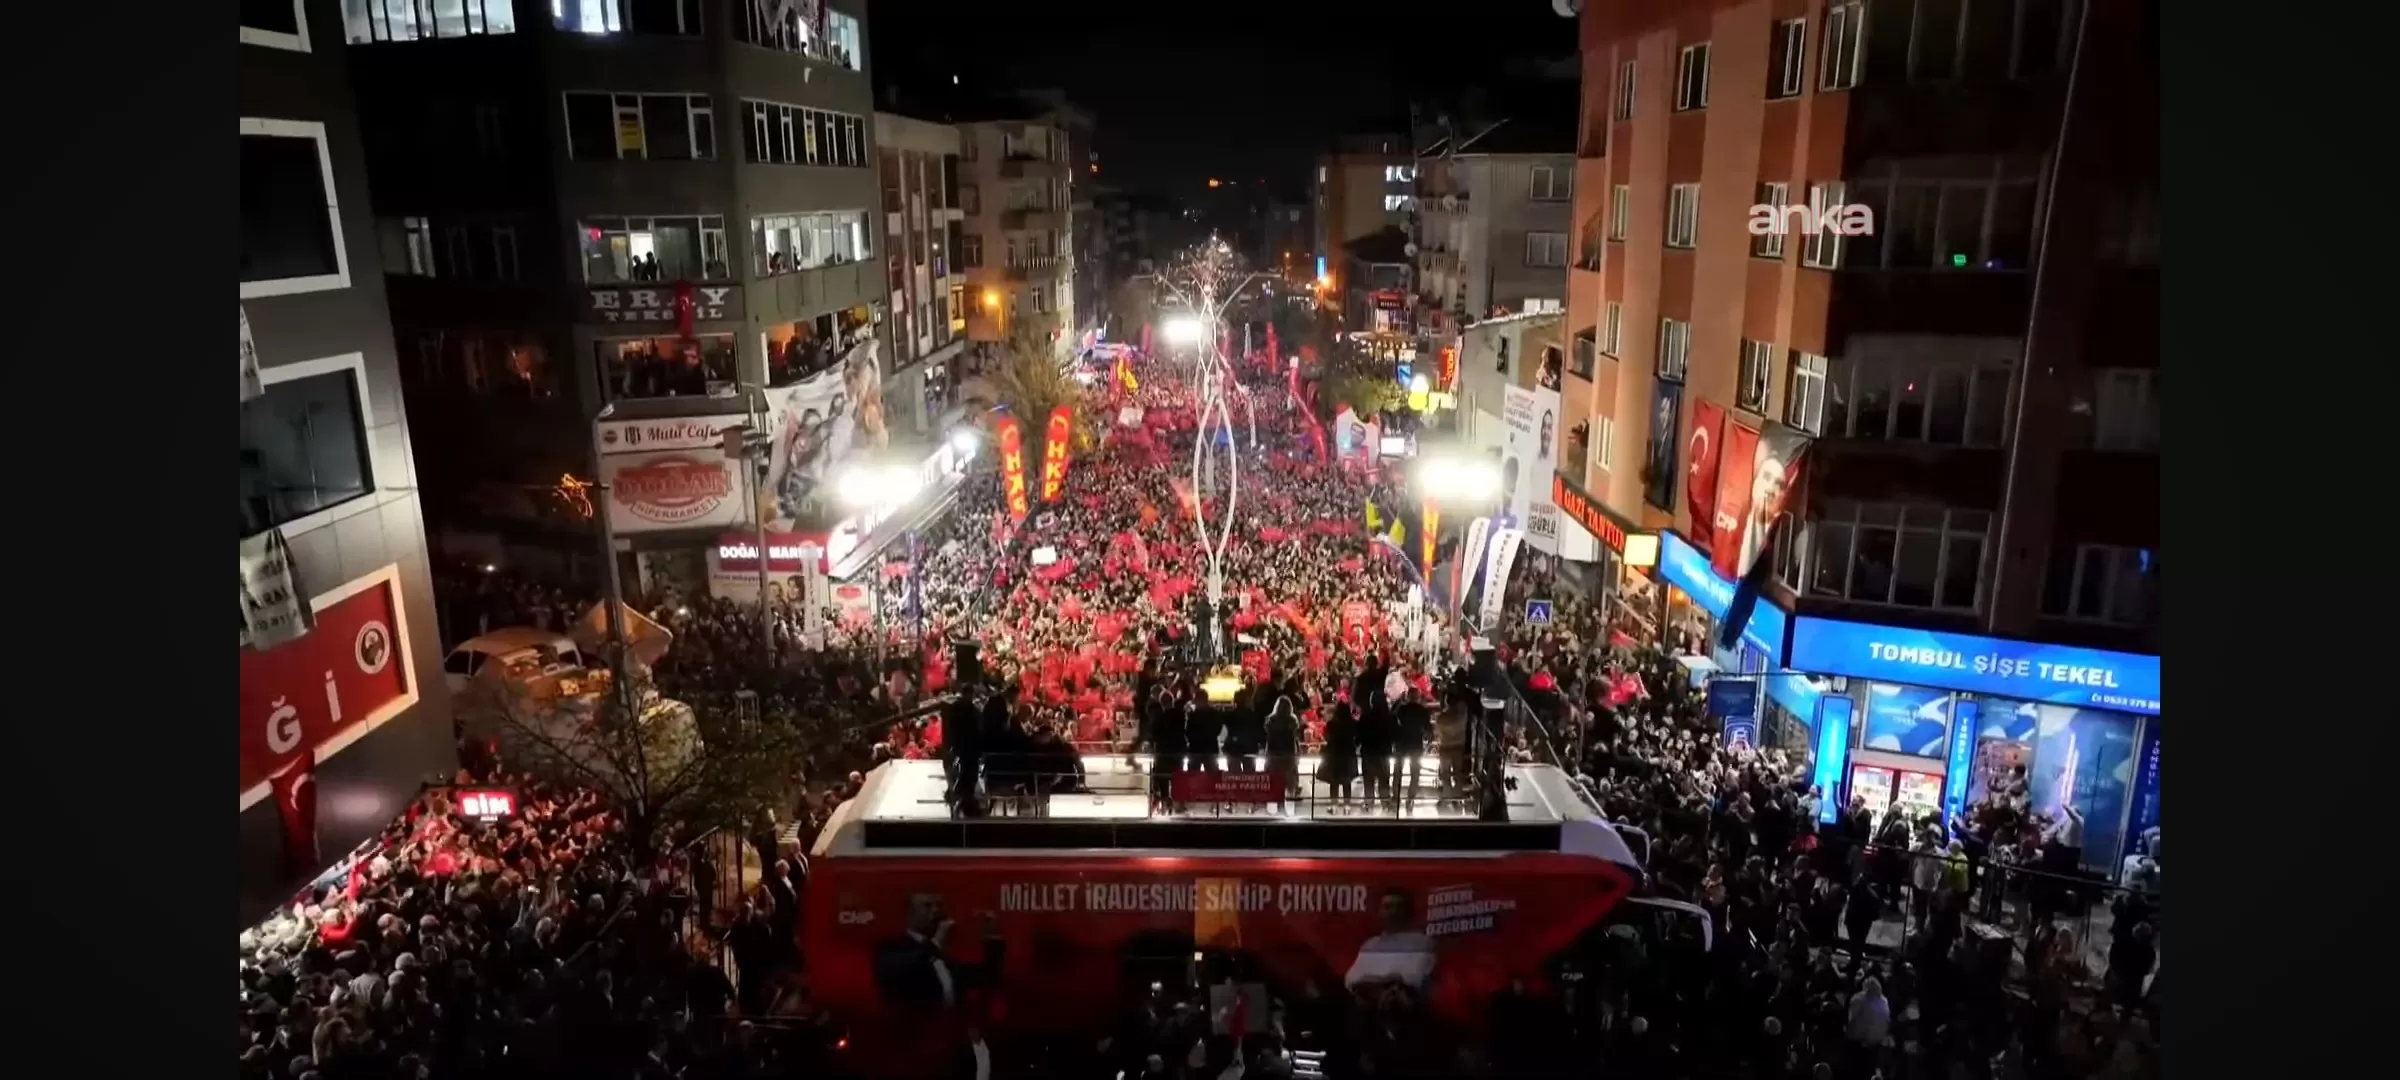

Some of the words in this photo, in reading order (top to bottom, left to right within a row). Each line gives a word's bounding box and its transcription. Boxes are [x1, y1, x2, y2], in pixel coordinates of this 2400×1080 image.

[590, 288, 729, 309] ERY
[604, 308, 723, 322] TEKSİL
[1044, 439, 1065, 498] HKP
[1563, 489, 1585, 522] GAZİ
[1587, 506, 1625, 552] TANTUN
[720, 542, 759, 559] DOĞA
[769, 545, 825, 559] MART
[1869, 642, 1967, 670] TOMBUL
[1972, 653, 2031, 679] ŞİŞE
[2037, 662, 2119, 688] TEKEL
[463, 793, 511, 815] BİM
[1000, 883, 1078, 911] MİLLET
[1085, 882, 1198, 911] İRADESİNE
[1205, 884, 1271, 912] SAHİP
[1277, 883, 1367, 915] ÇIKIYOR
